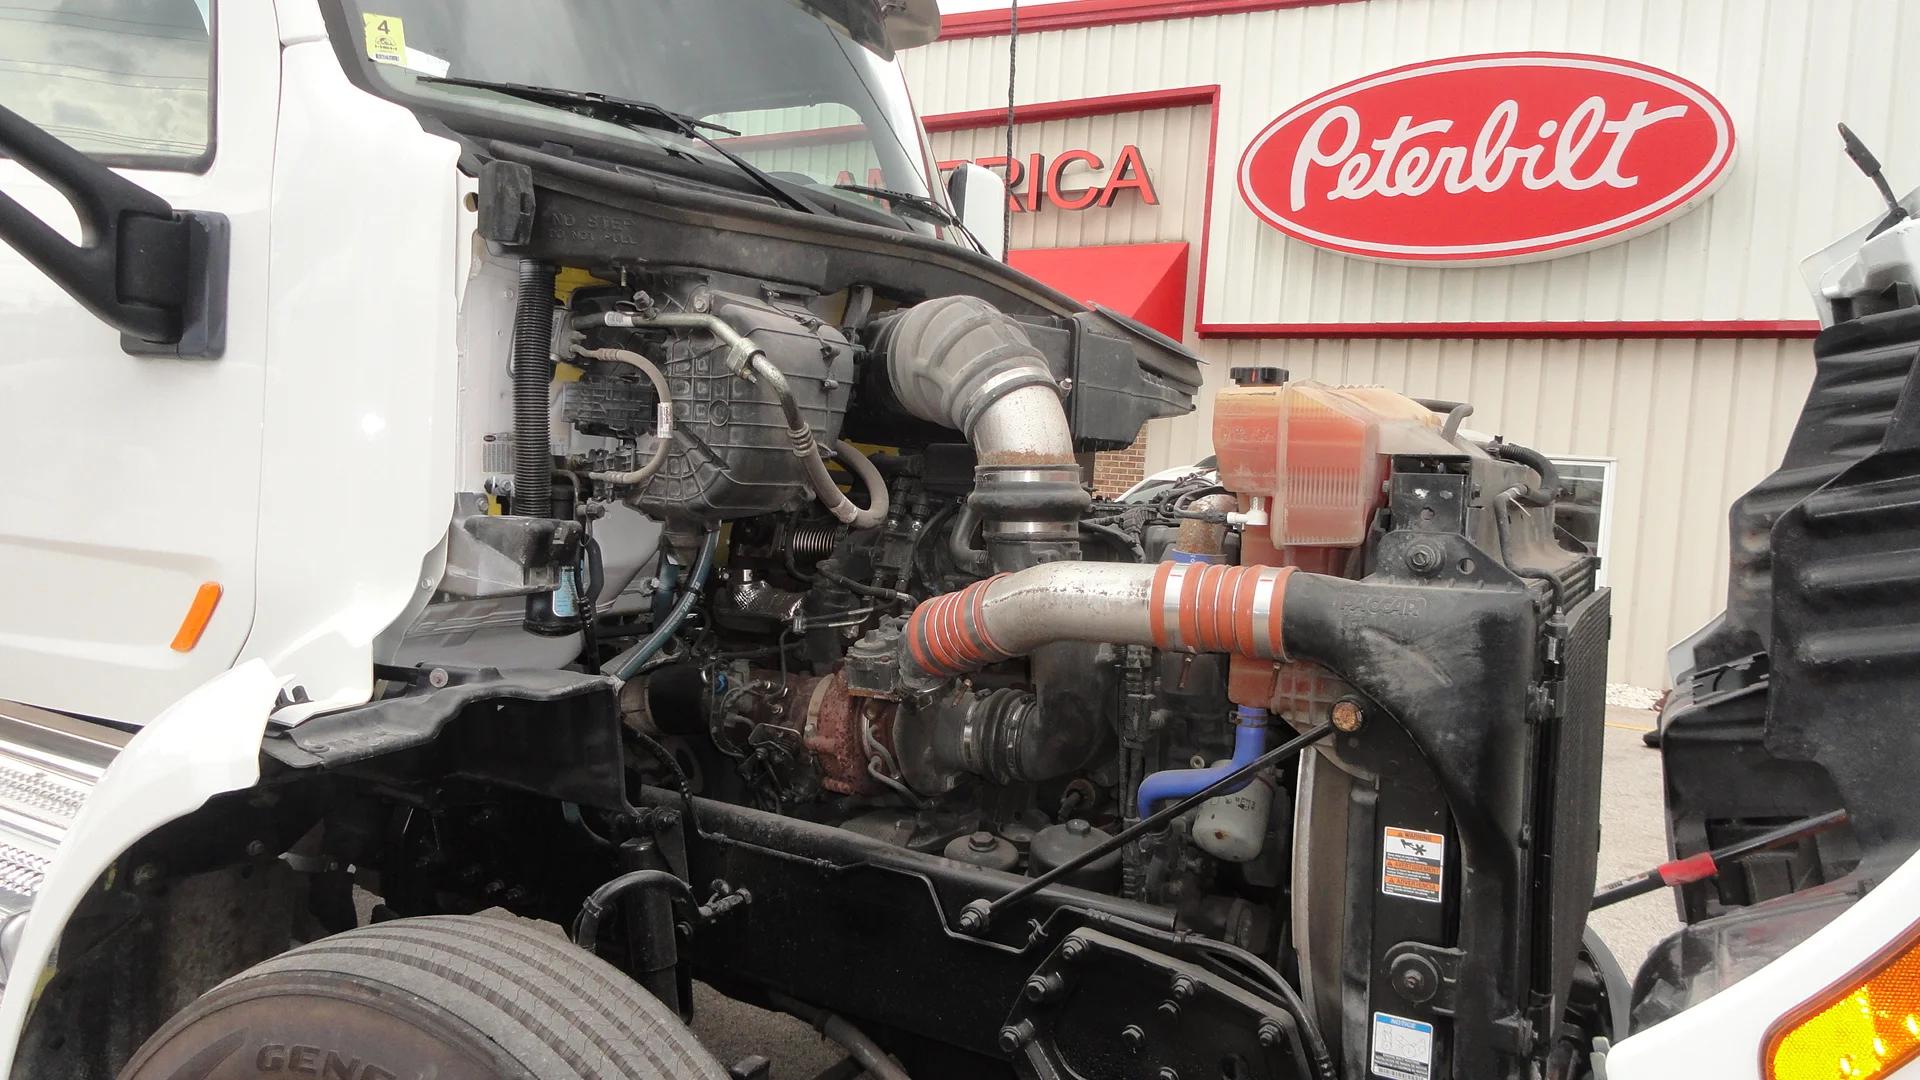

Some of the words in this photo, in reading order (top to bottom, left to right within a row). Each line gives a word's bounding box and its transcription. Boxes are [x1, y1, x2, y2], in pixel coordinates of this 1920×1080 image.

[377, 20, 390, 35] 4
[1290, 96, 1688, 212] Peterbilt
[836, 145, 1159, 214] RICA
[551, 212, 575, 226] NO
